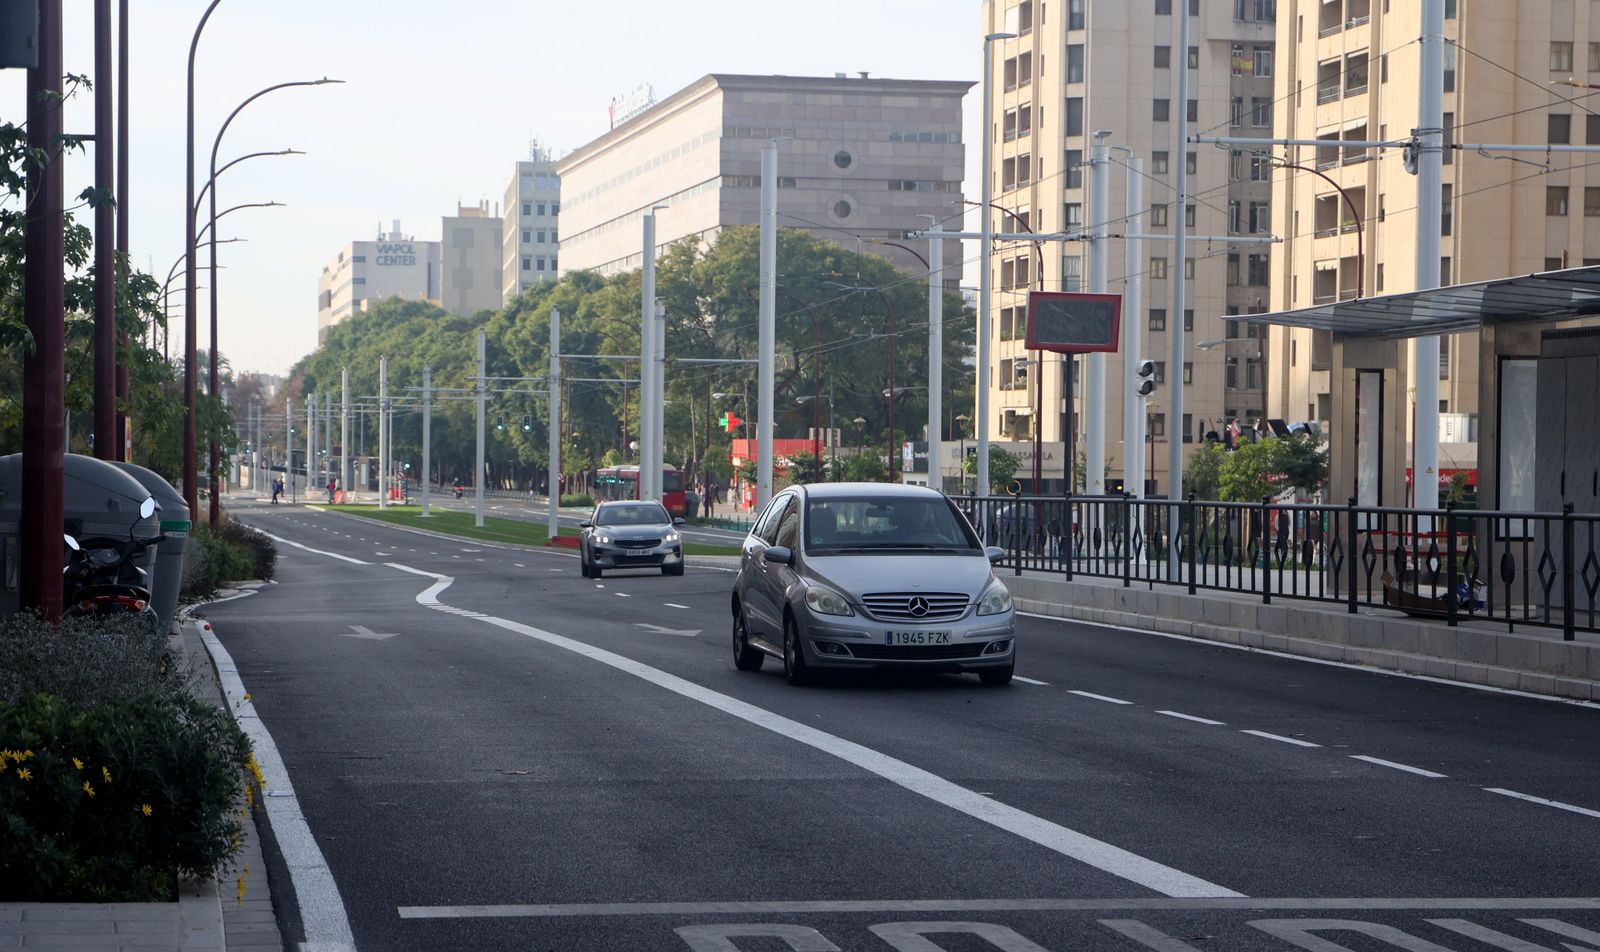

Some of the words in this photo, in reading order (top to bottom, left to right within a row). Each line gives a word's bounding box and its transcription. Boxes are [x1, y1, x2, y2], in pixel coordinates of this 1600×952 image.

[376, 244, 416, 254] VIAPOL
[376, 255, 416, 265] CENTER
[896, 632, 925, 644] 1945
[928, 632, 949, 644] FZK
